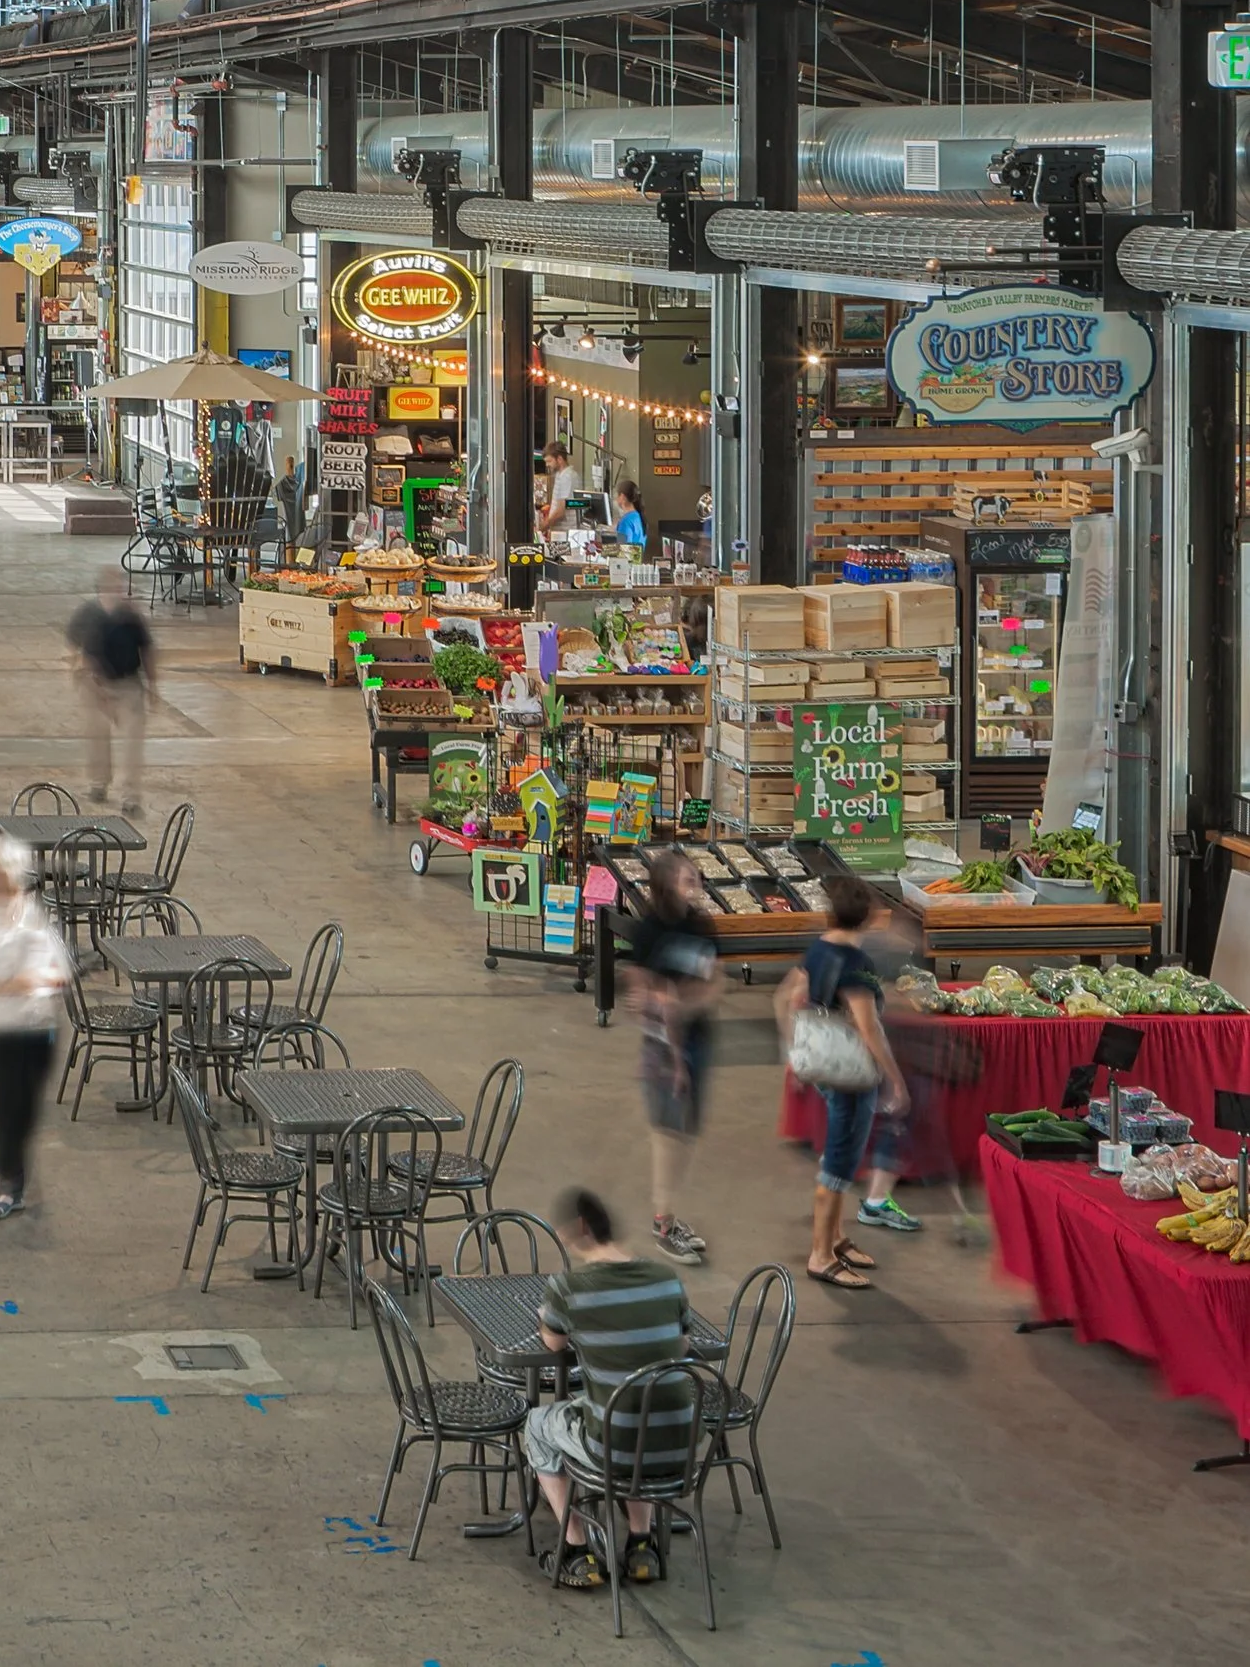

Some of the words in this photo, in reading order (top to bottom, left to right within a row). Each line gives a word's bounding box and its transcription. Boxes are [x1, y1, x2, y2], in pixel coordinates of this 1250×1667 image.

[196, 265, 250, 274] MISSION
[260, 266, 299, 276] RIDGE
[372, 254, 447, 276] Auvil's
[367, 287, 402, 306] GEE
[402, 286, 451, 305] WHIZ
[947, 296, 993, 314] WENATCHEE
[994, 294, 1023, 306] VALLEY
[1024, 292, 1060, 307] FARMERS
[1061, 297, 1094, 312] MARKET
[356, 314, 414, 339] Select
[418, 312, 464, 339] Fruit
[918, 313, 1099, 374] COUNTRY
[1000, 357, 1123, 401] STORE
[326, 387, 372, 402] FRUIT
[329, 406, 368, 418] MILK
[318, 421, 379, 434] SHAKES
[324, 444, 365, 456] ROOT
[322, 460, 364, 472] BEER
[320, 476, 365, 490] FLOATS
[970, 534, 1006, 561] Local
[1046, 534, 1070, 548] Egg
[812, 717, 886, 745] Local
[812, 756, 887, 781] Farm
[811, 790, 889, 818] Fresh
